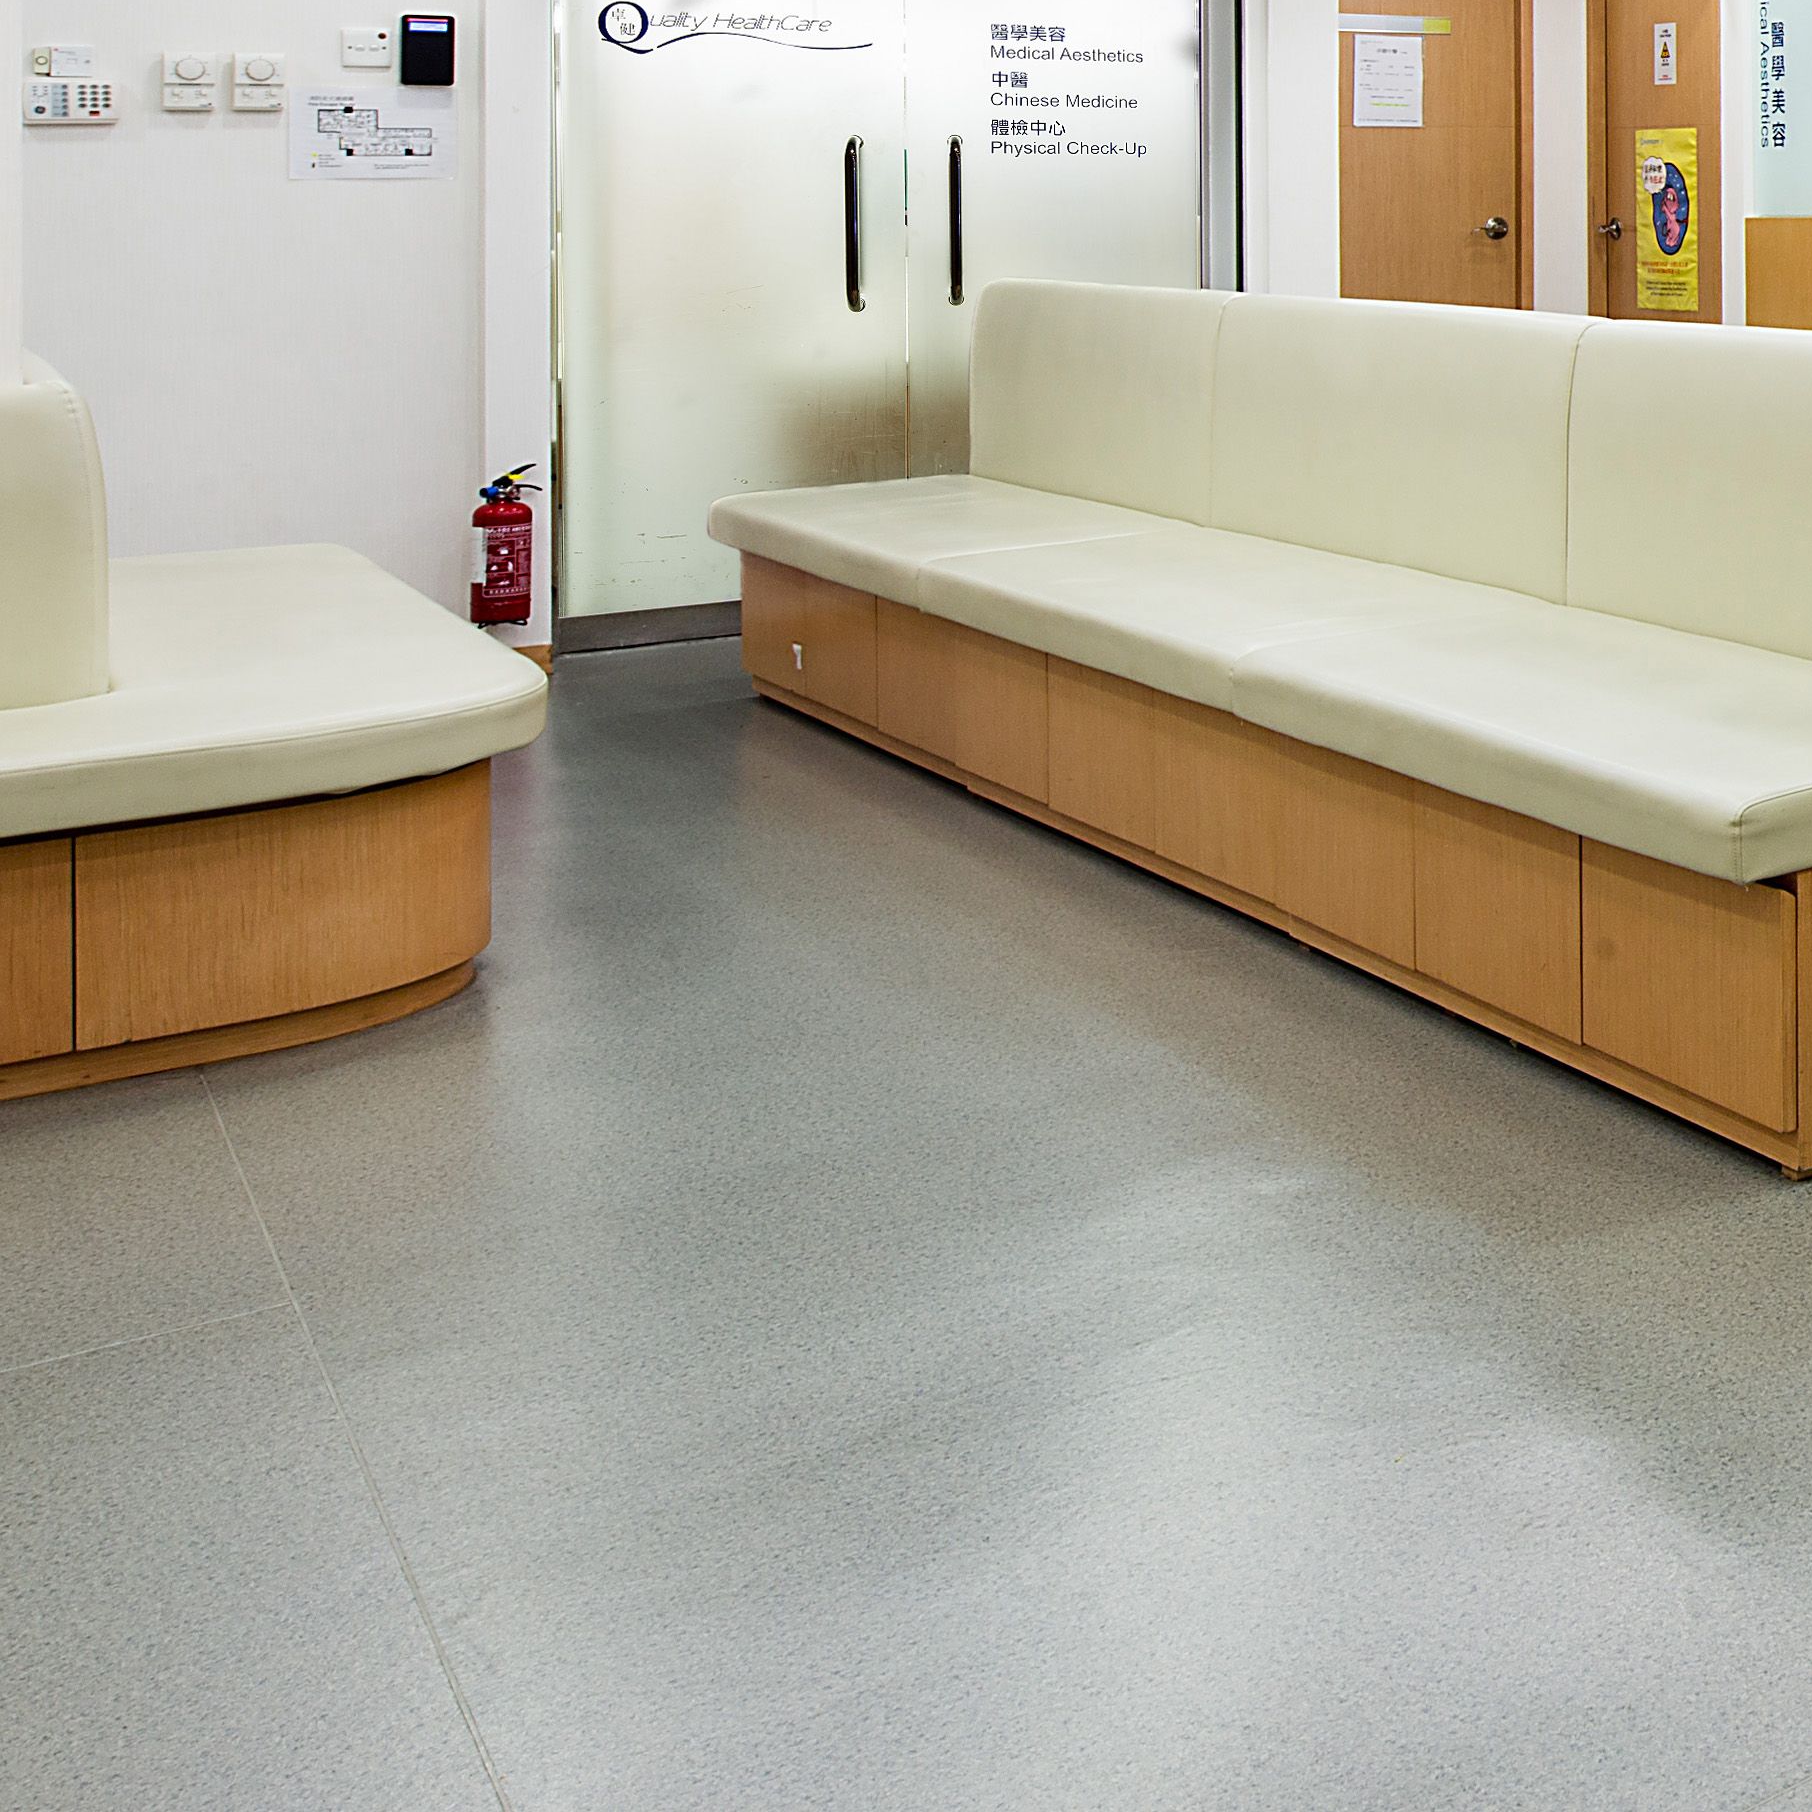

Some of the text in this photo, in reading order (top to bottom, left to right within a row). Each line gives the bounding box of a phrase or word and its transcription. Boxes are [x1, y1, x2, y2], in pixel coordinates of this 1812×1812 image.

[598, 1, 832, 54] Quality HealthCare
[991, 23, 1066, 42] 醫學美容
[990, 45, 1144, 63] Medical Aesthetics
[992, 71, 1028, 88] 中醫
[1771, 21, 1786, 148] 醫學美容
[990, 92, 1138, 109] Chinese Medicine
[1760, 41, 1770, 148] Aesthetics
[991, 119, 1066, 136] 體檢中心
[991, 141, 1147, 158] Physical Check-Up
